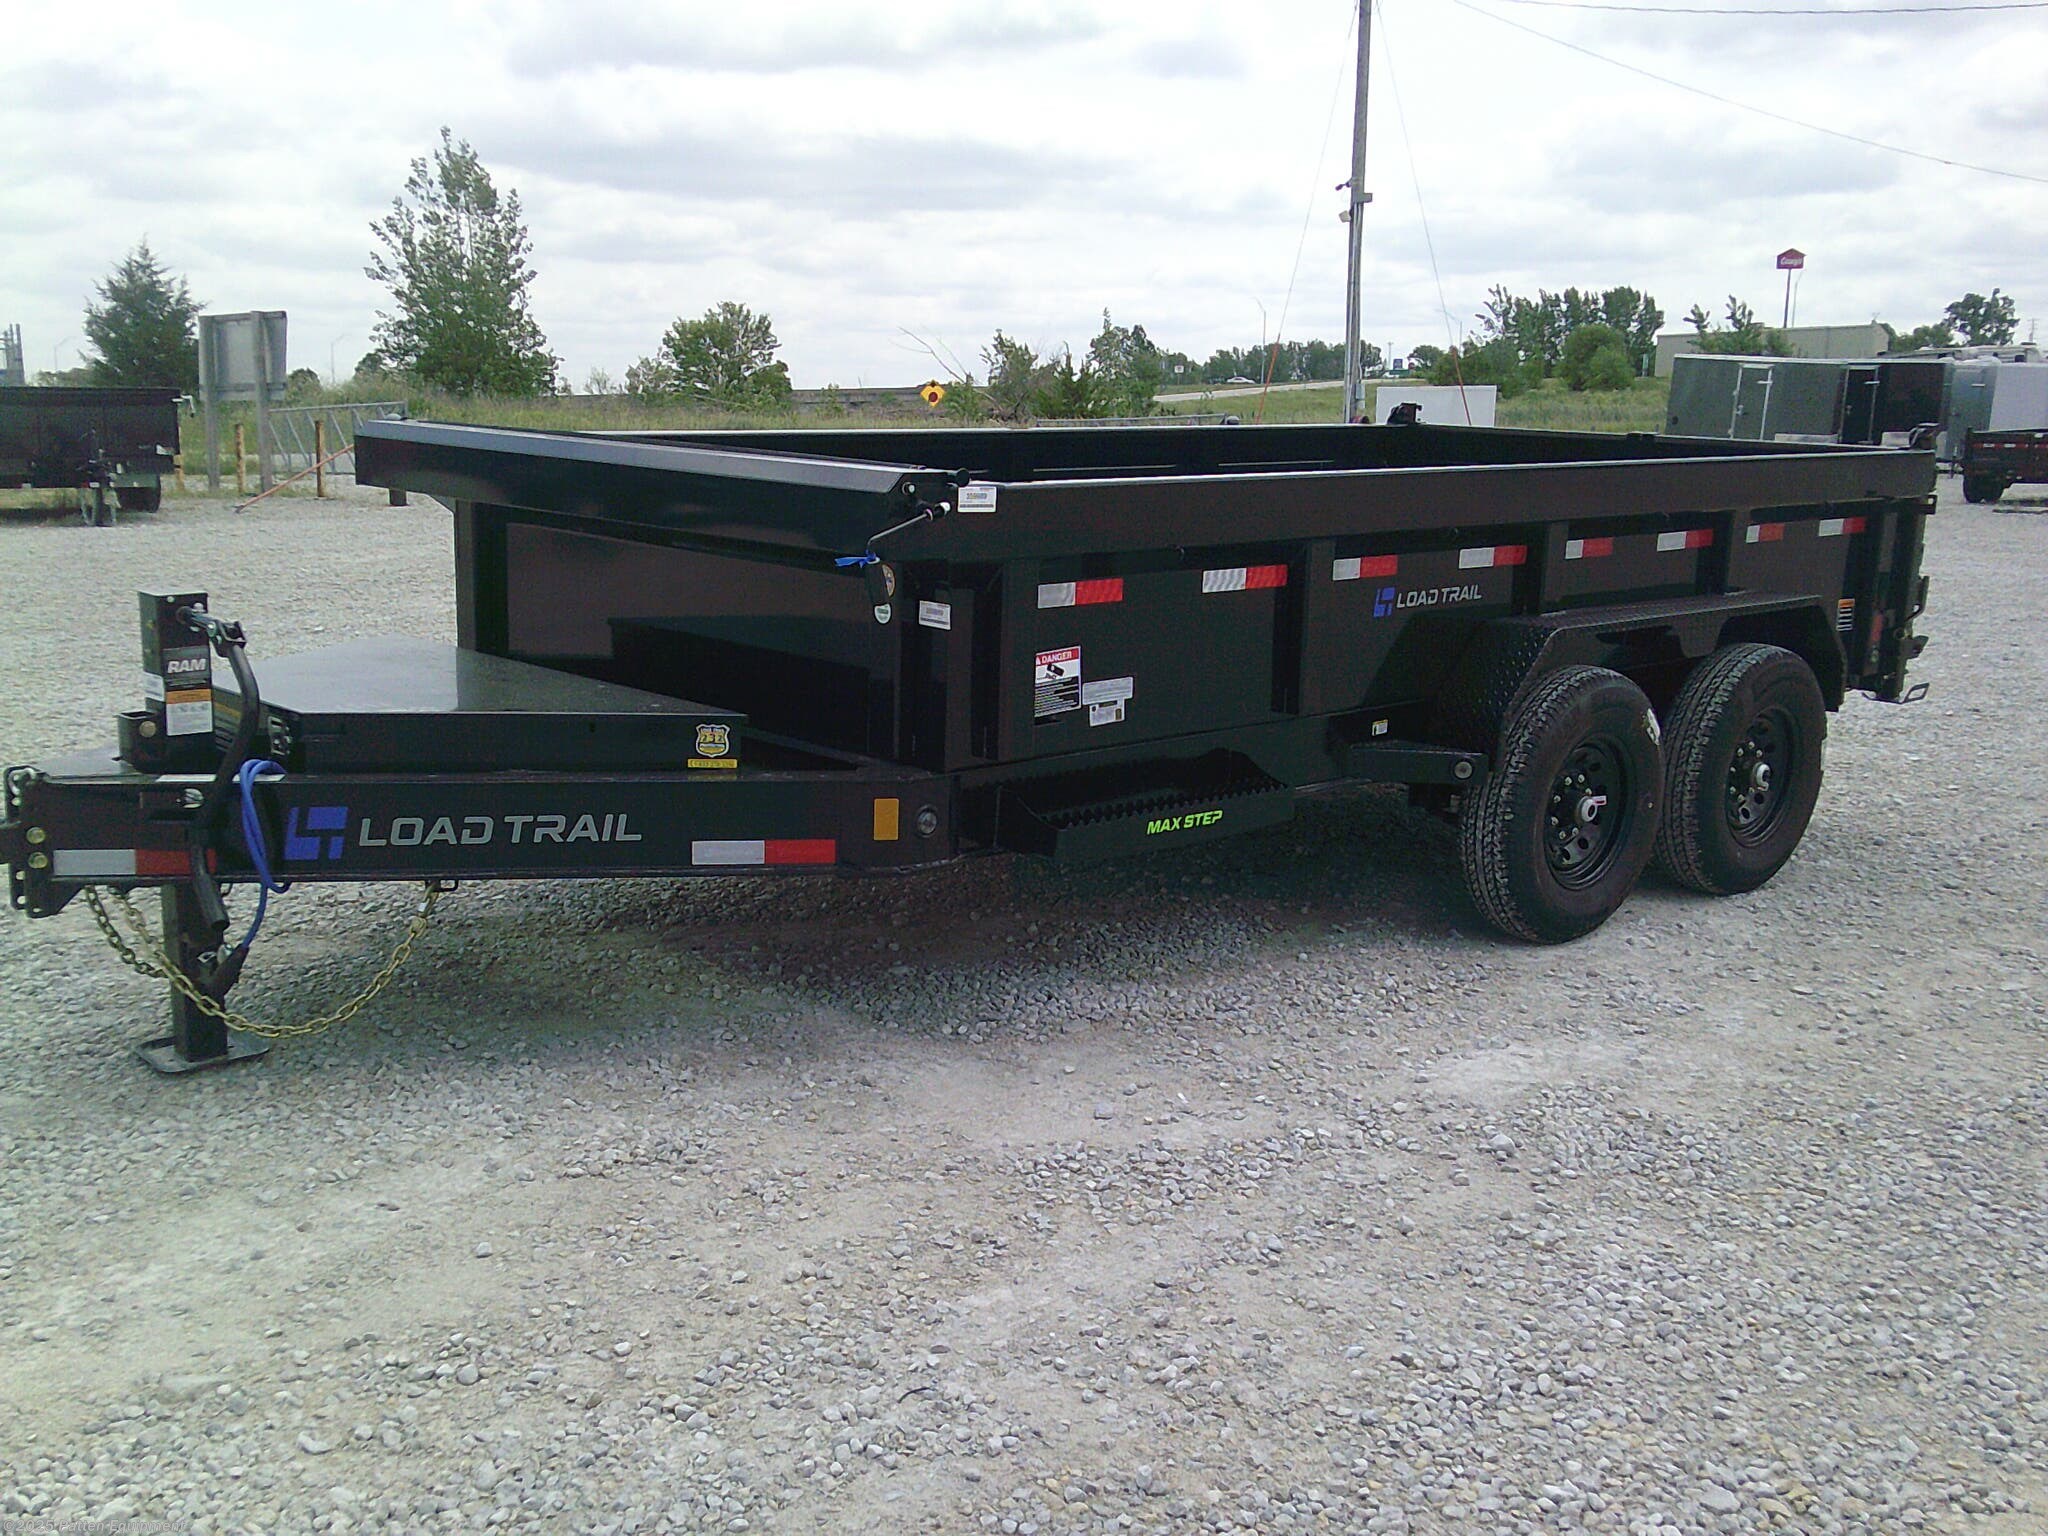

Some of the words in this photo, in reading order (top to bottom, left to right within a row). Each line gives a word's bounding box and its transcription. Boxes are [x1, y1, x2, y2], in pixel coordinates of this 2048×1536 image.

[1397, 588, 1439, 609] LOAD
[1441, 584, 1483, 604] TRAIL
[167, 658, 207, 674] RAM
[1041, 650, 1073, 665] DANGER
[359, 816, 495, 847] LOAD
[504, 813, 642, 844] TRAIL
[1146, 816, 1183, 835] MAX
[1183, 810, 1224, 829] STEP
